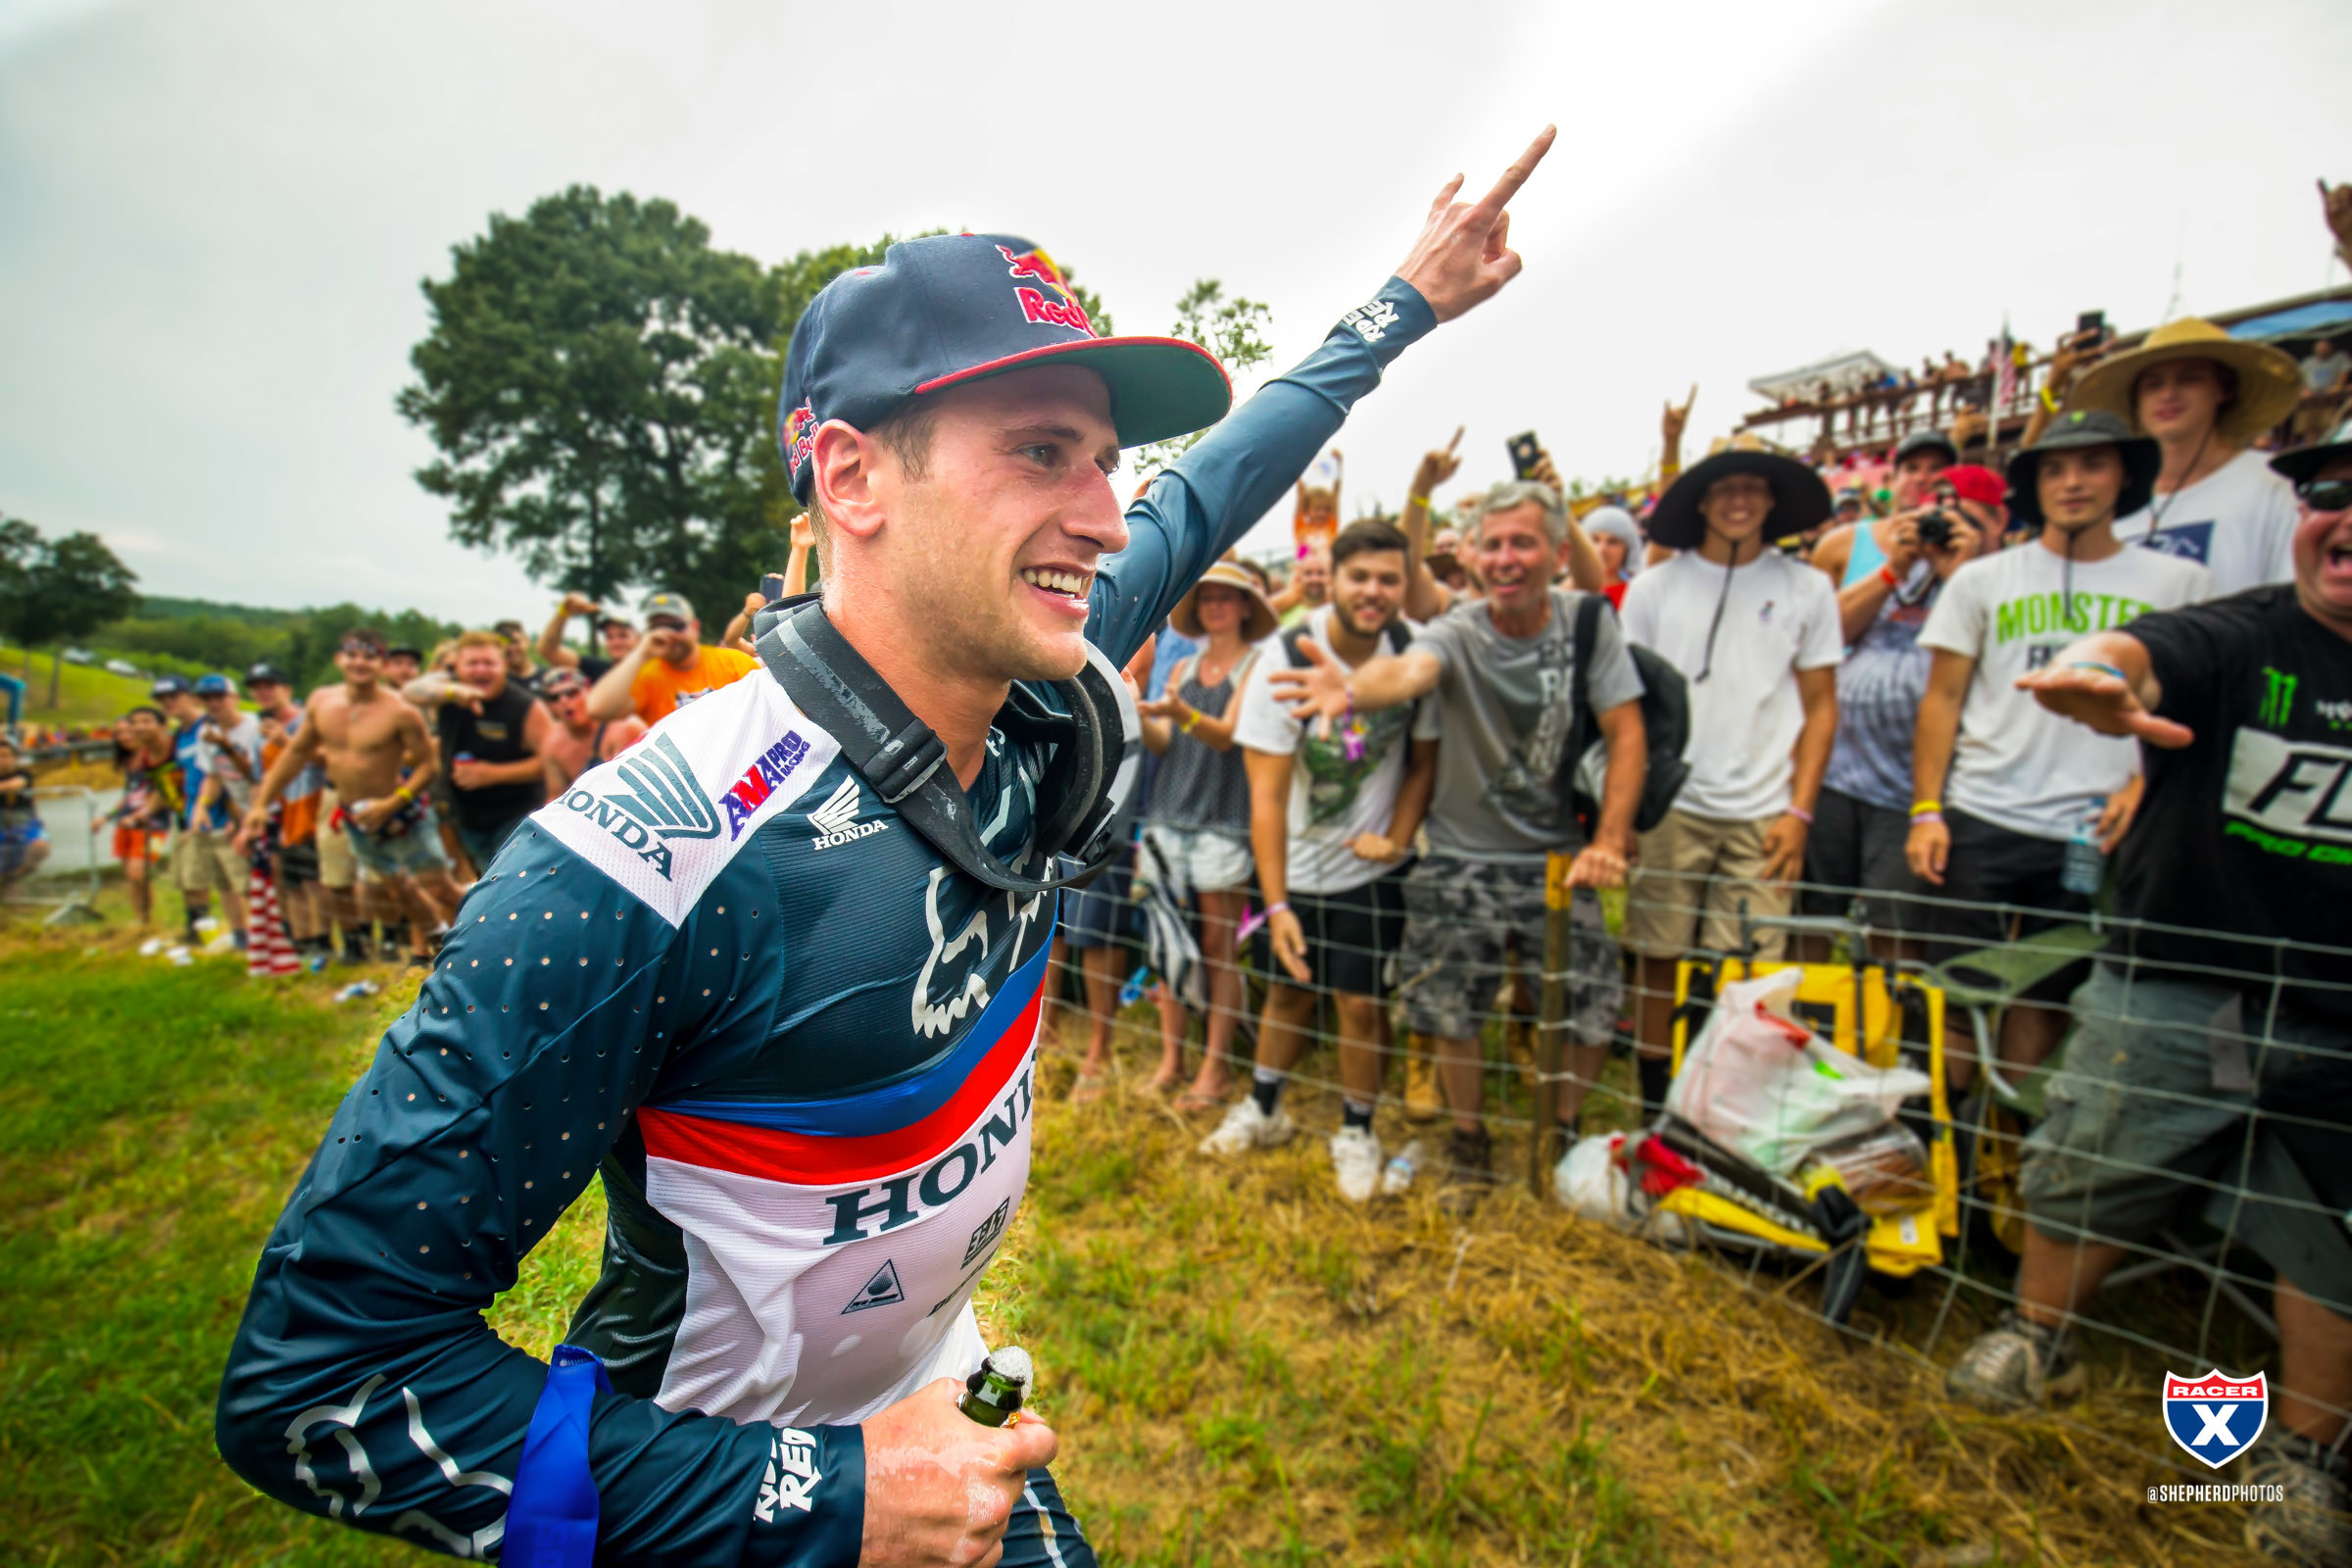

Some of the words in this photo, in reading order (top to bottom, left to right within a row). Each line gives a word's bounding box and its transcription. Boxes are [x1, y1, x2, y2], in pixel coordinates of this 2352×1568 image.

[1013, 286, 1086, 331] Red
[1359, 298, 1400, 329] RE
[780, 741, 811, 778] RACING
[717, 754, 787, 842] AMA
[765, 729, 804, 769] PRO
[812, 818, 889, 851] HONDA
[779, 1427, 823, 1512] RED
